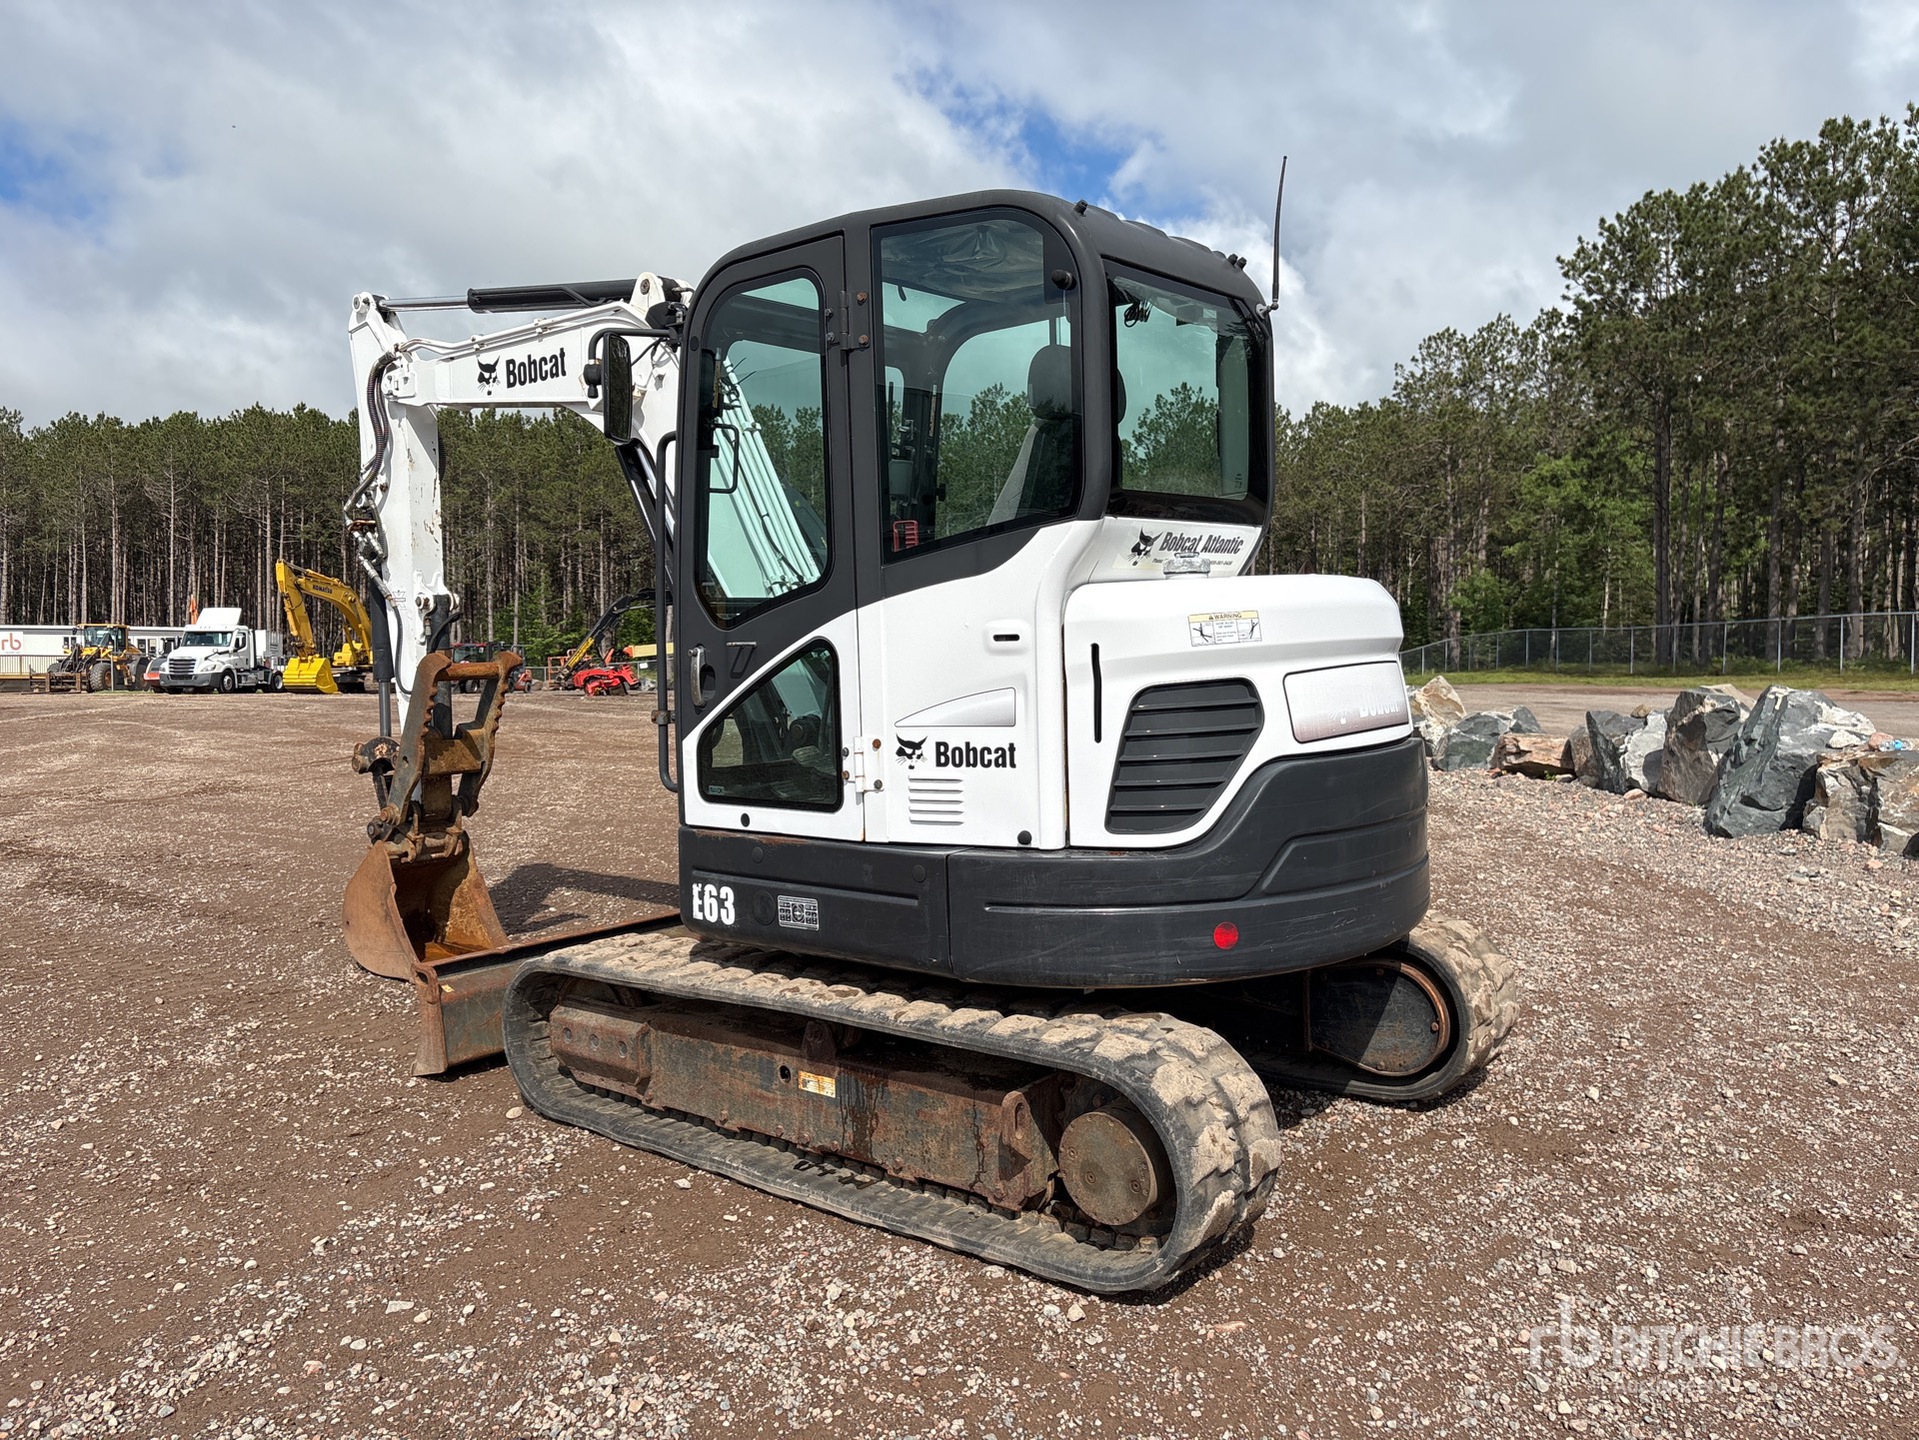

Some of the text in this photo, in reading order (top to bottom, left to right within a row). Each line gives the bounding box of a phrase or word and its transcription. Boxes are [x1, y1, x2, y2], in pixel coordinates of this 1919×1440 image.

[506, 347, 567, 389] Bobcat
[1159, 532, 1244, 555] Bobcat Atlantic
[1213, 612, 1242, 620] WARNING
[1, 632, 22, 651] rb
[935, 741, 1017, 769] Bobcat
[692, 883, 735, 925] E63
